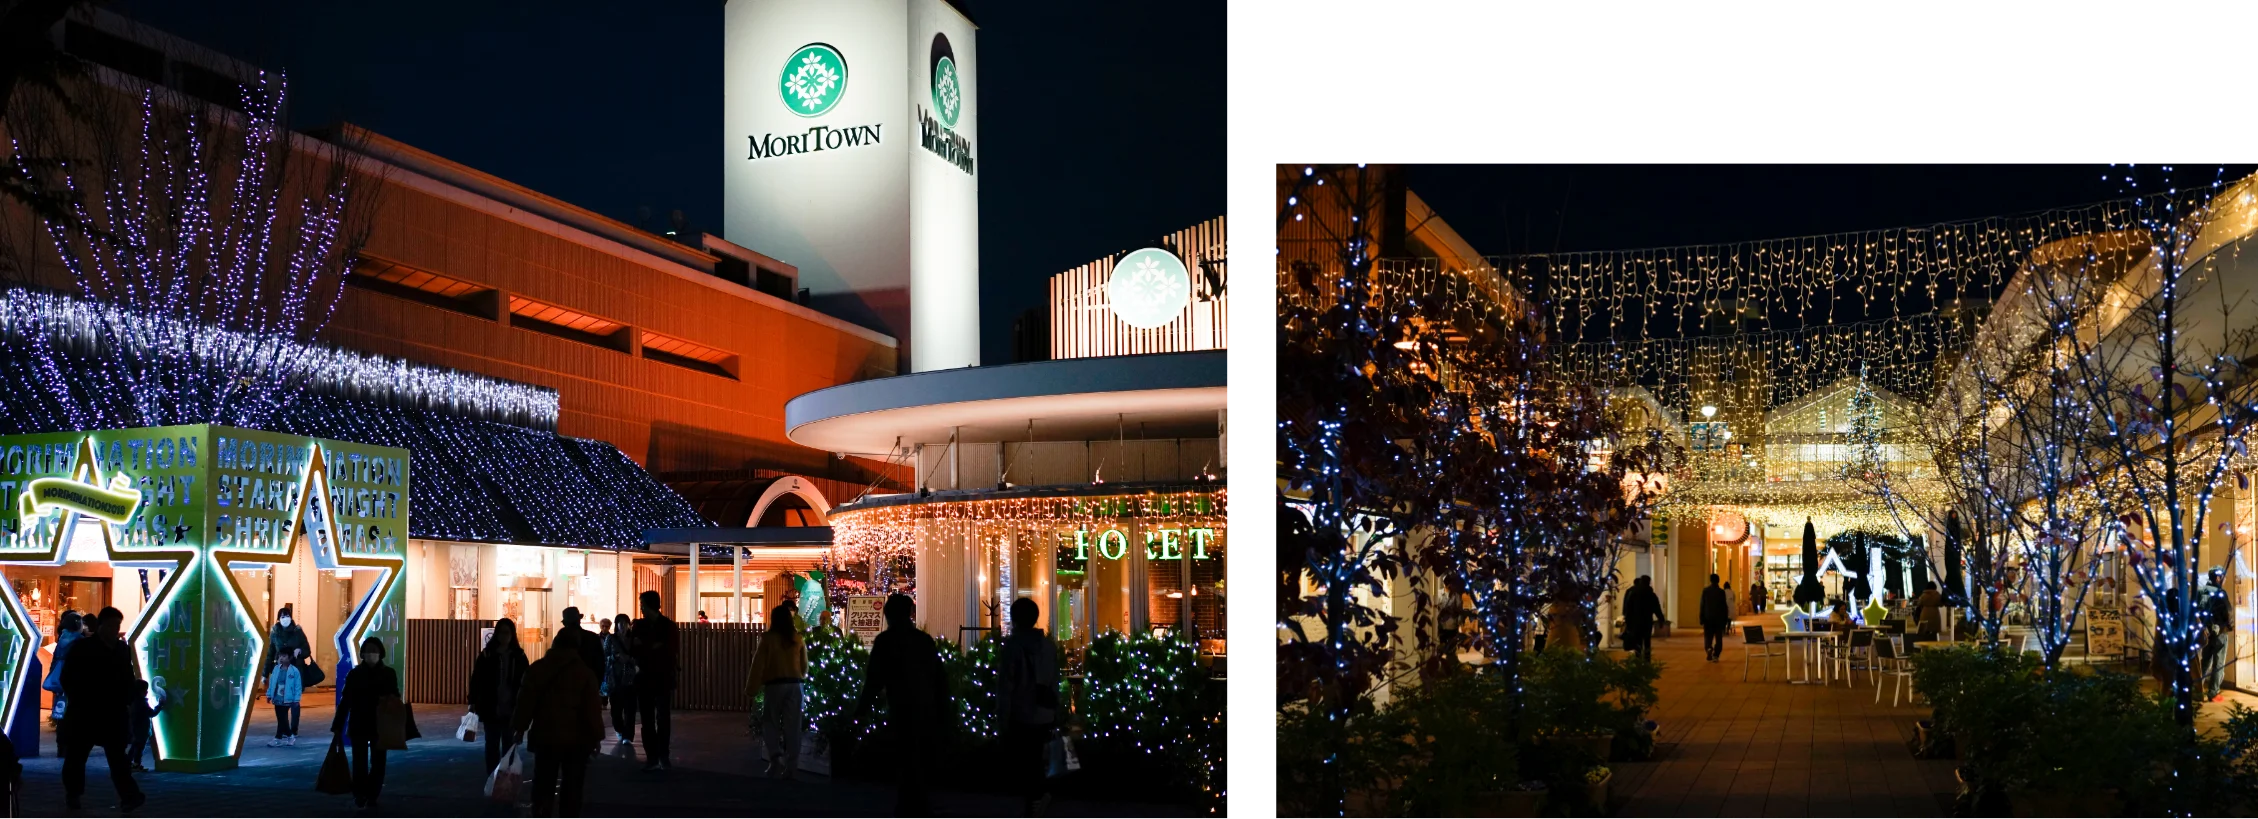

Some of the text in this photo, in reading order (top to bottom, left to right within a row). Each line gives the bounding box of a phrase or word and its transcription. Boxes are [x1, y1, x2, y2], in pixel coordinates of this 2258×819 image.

[0, 436, 197, 475] ORIMNATION
[216, 514, 380, 554] CHRISMAS
[850, 611, 881, 619] クリスマス
